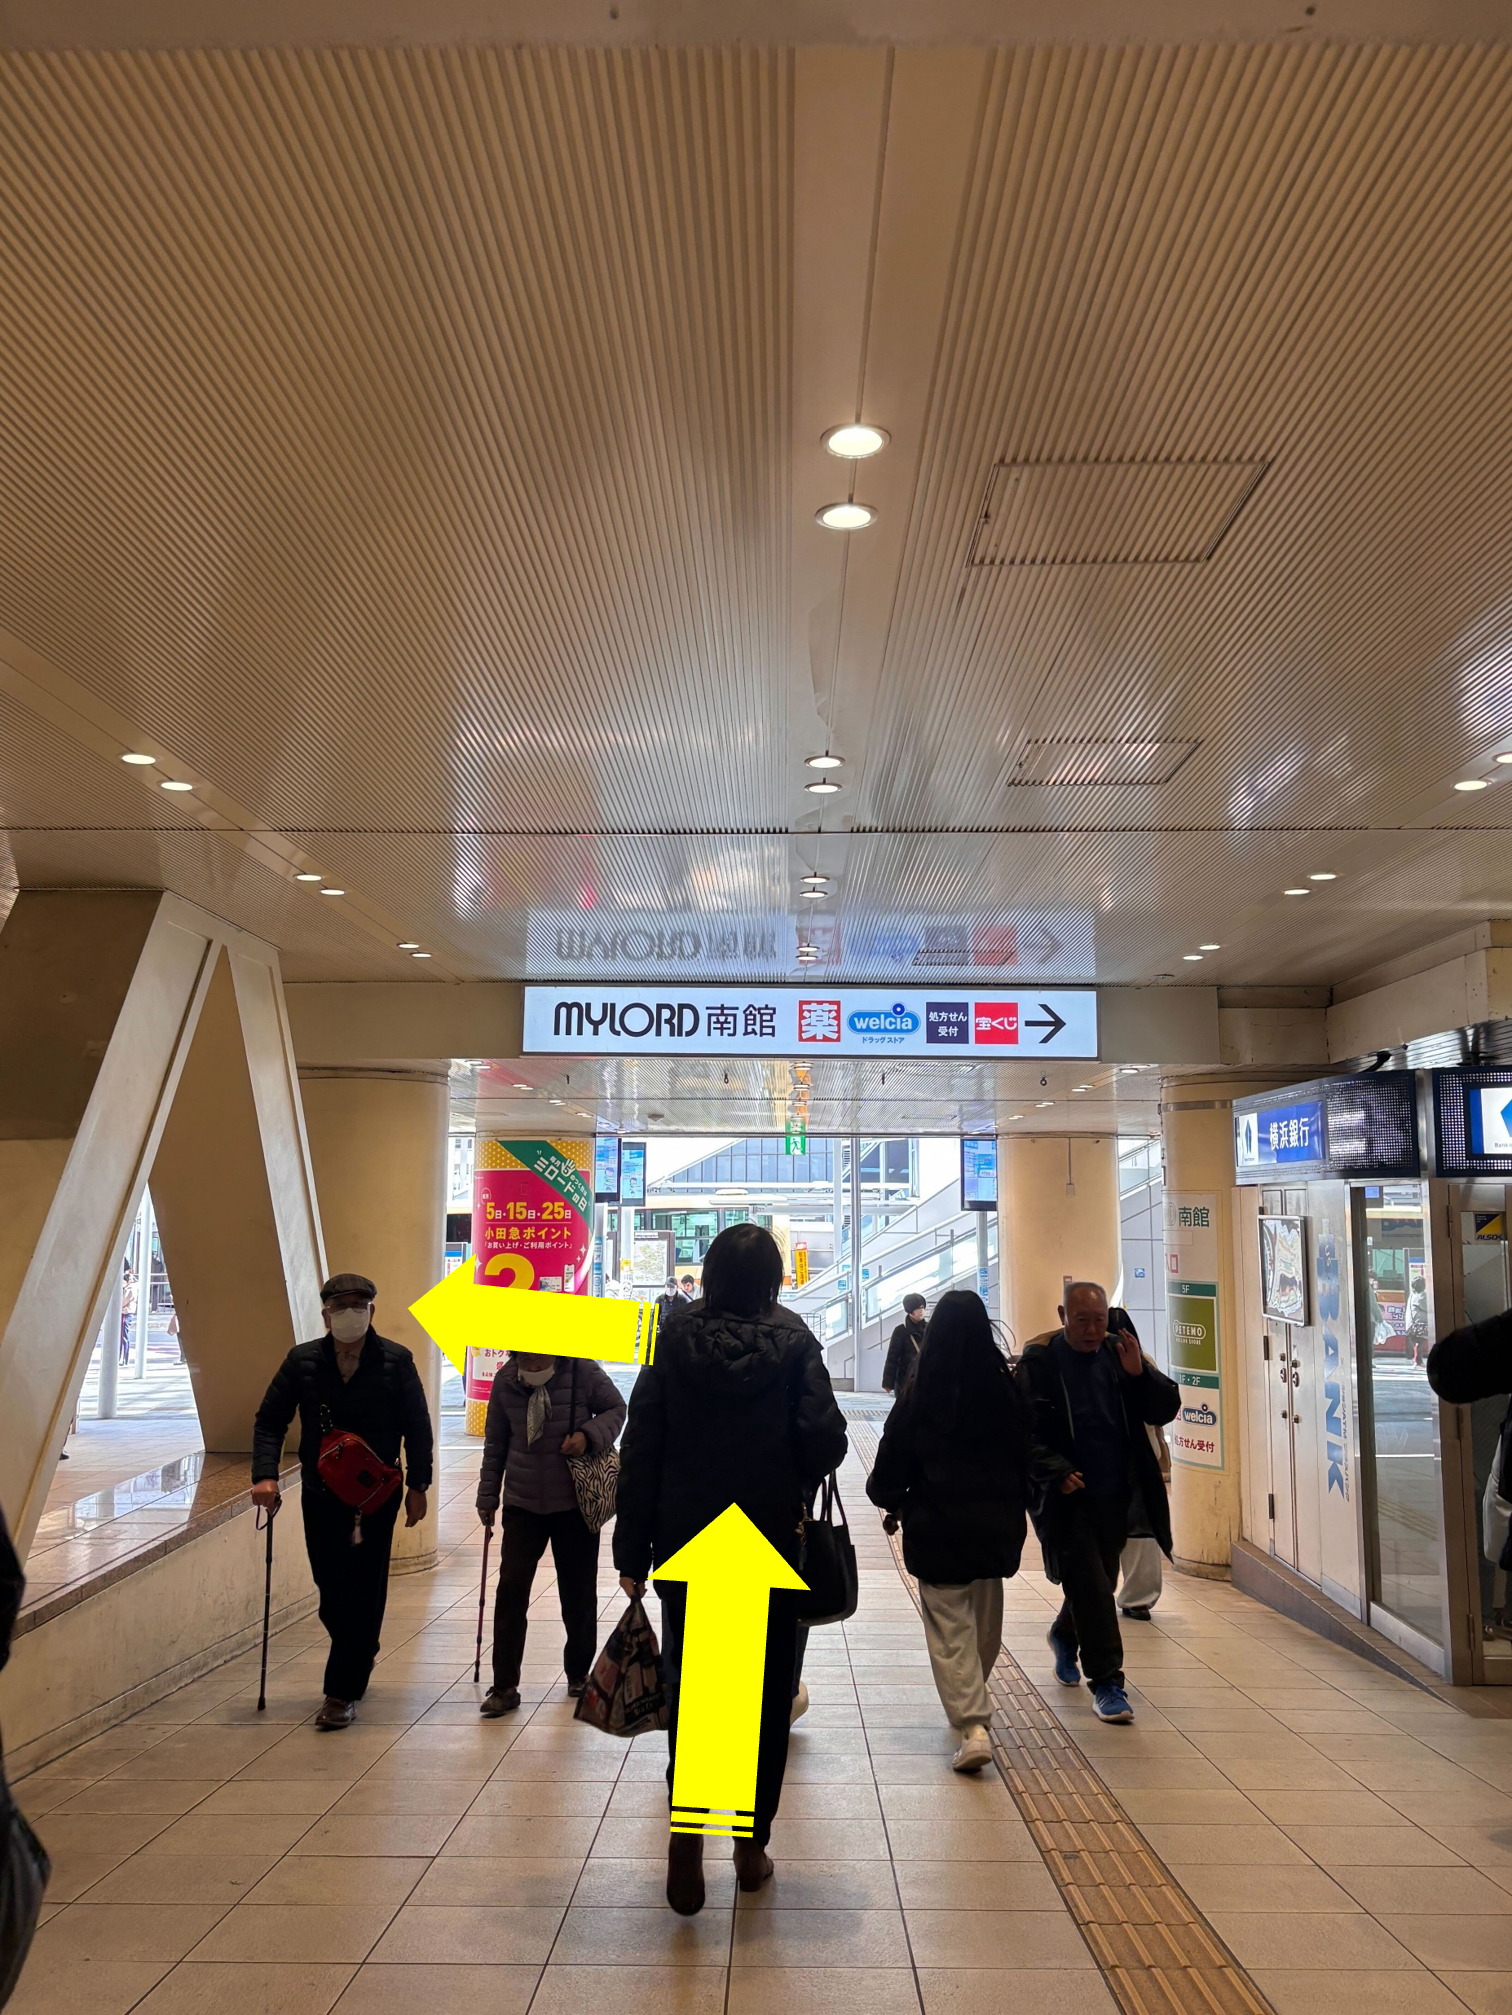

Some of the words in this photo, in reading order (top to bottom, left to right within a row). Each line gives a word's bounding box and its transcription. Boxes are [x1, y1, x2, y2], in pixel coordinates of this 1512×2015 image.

[553, 1001, 700, 1038] MYLORD
[705, 1003, 777, 1038] 南館
[800, 1002, 839, 1040] 薬
[853, 1012, 913, 1031] welcia
[928, 1010, 968, 1023] 処方せん
[975, 1016, 1018, 1032] 宝くじ
[937, 1025, 959, 1037] 受付
[1269, 1117, 1310, 1151] 横浜銀行
[1178, 1206, 1210, 1228] 南館
[484, 1226, 572, 1240] 小田急ポイント
[1181, 1284, 1190, 1294] 5F
[1184, 1410, 1213, 1425] welcia
